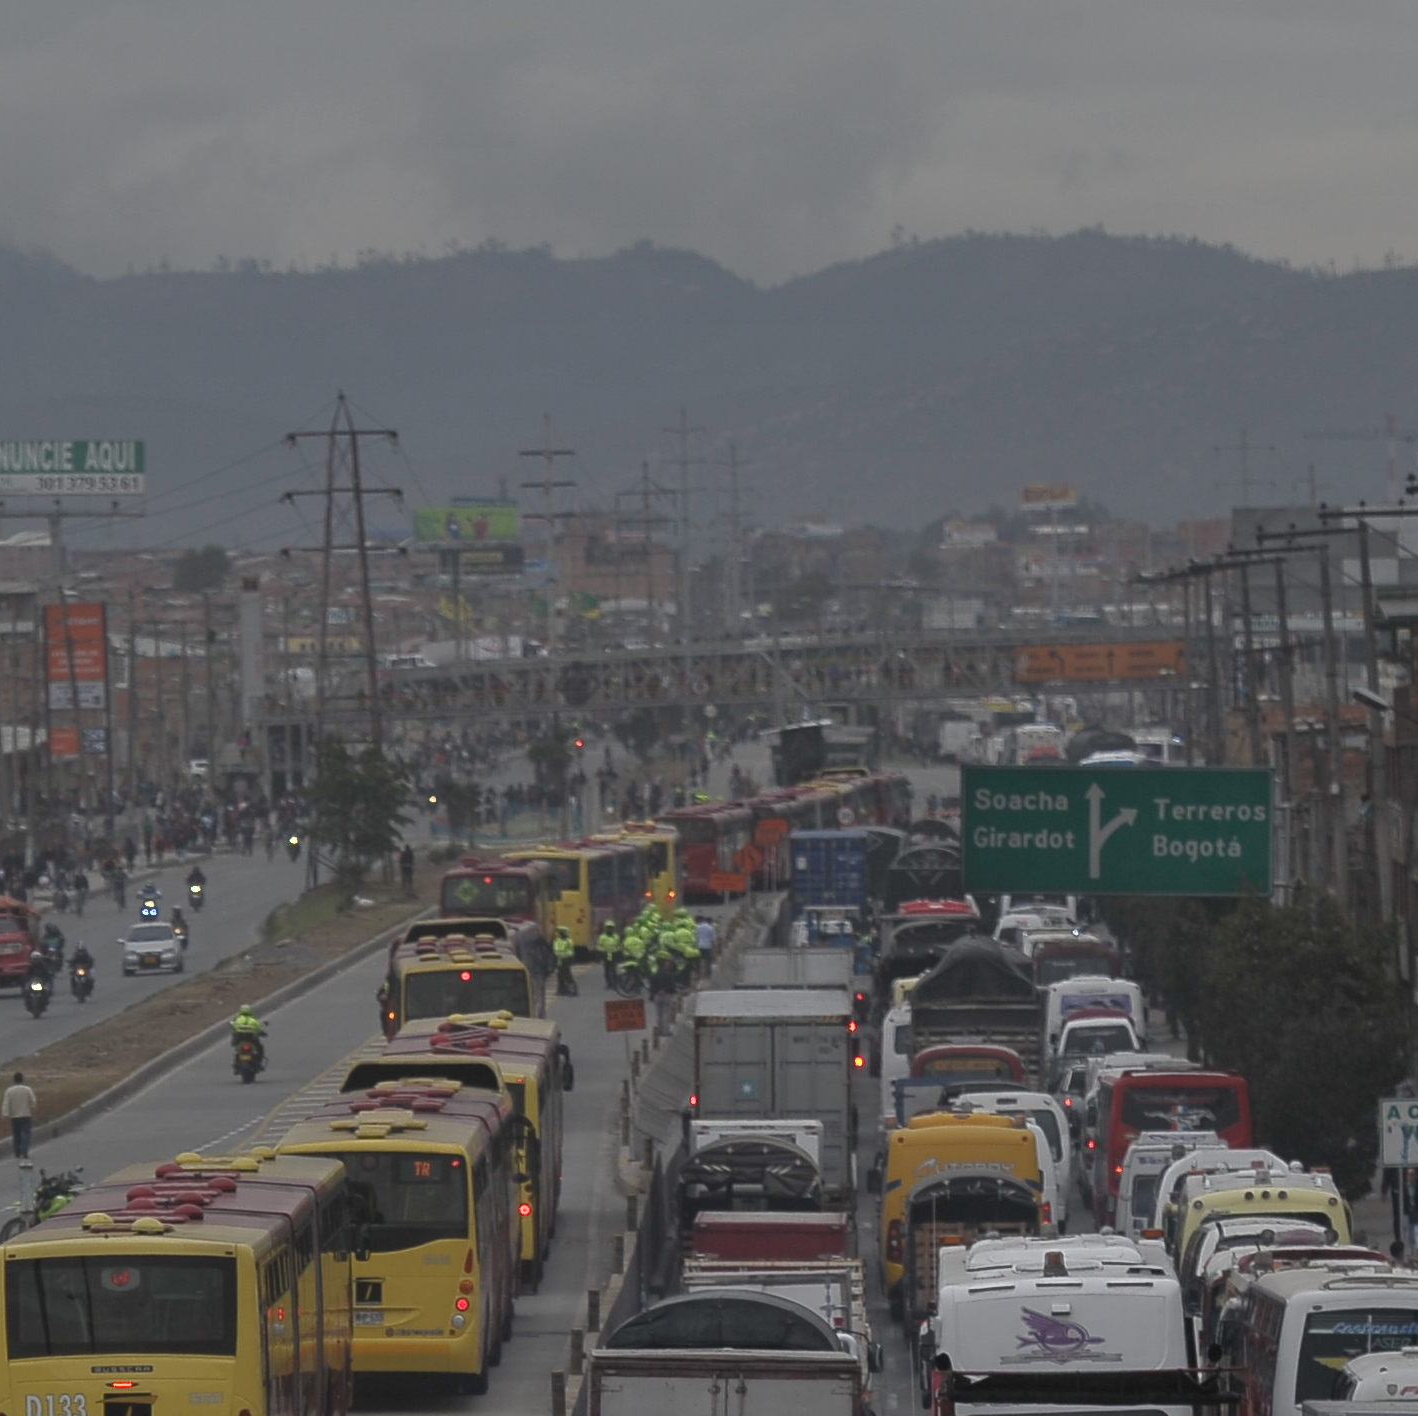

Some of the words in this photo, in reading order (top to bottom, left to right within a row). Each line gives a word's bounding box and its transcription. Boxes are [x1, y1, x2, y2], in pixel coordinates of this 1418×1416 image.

[83, 440, 137, 471] AQUI
[974, 787, 1070, 813] Soacha
[1153, 798, 1267, 822] Terreros
[973, 827, 1076, 849] Girardot
[1153, 835, 1243, 863] Bogotá
[1387, 1104, 1402, 1120] A
[414, 1160, 430, 1177] TR
[93, 1365, 152, 1373] BUSSCAR
